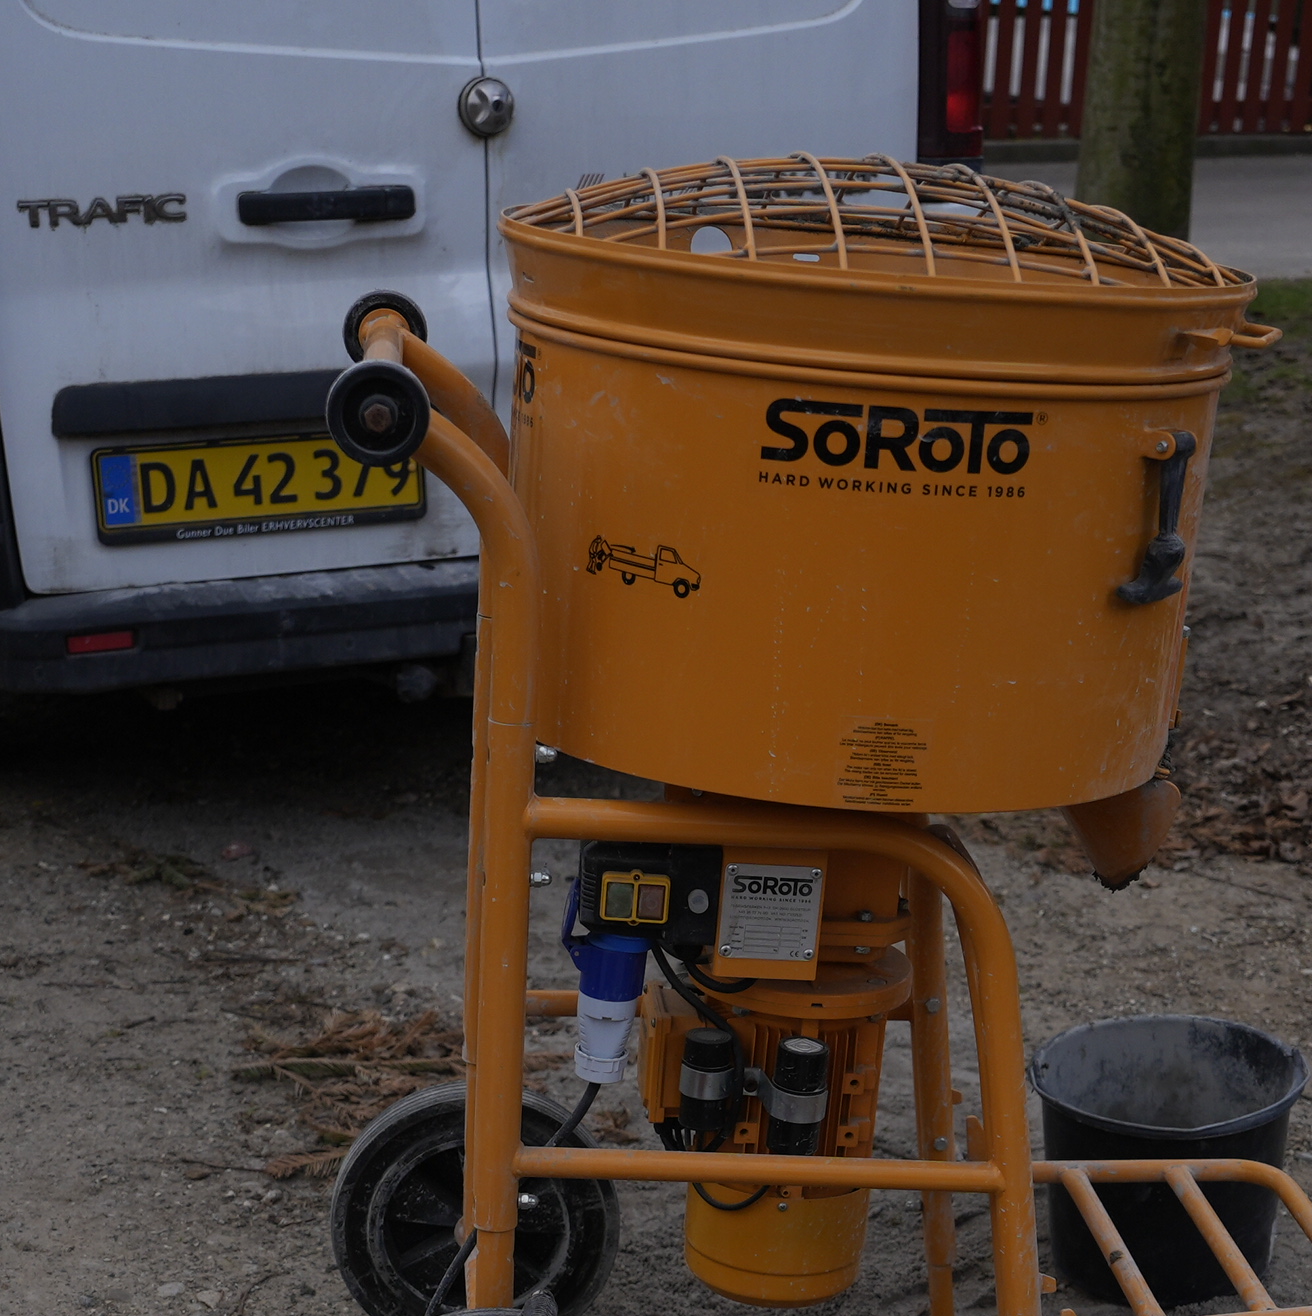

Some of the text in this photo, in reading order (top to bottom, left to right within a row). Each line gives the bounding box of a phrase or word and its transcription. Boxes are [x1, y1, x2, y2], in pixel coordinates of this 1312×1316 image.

[16, 193, 186, 229] TRAFIC
[140, 458, 218, 514] DA
[233, 452, 298, 505] 42
[758, 471, 1026, 498] HARD WORKING SINCE 1986
[108, 497, 130, 514] DK
[214, 525, 234, 537] Due
[237, 524, 259, 534] Biler
[261, 514, 355, 533] ERHVERVSCENTER
